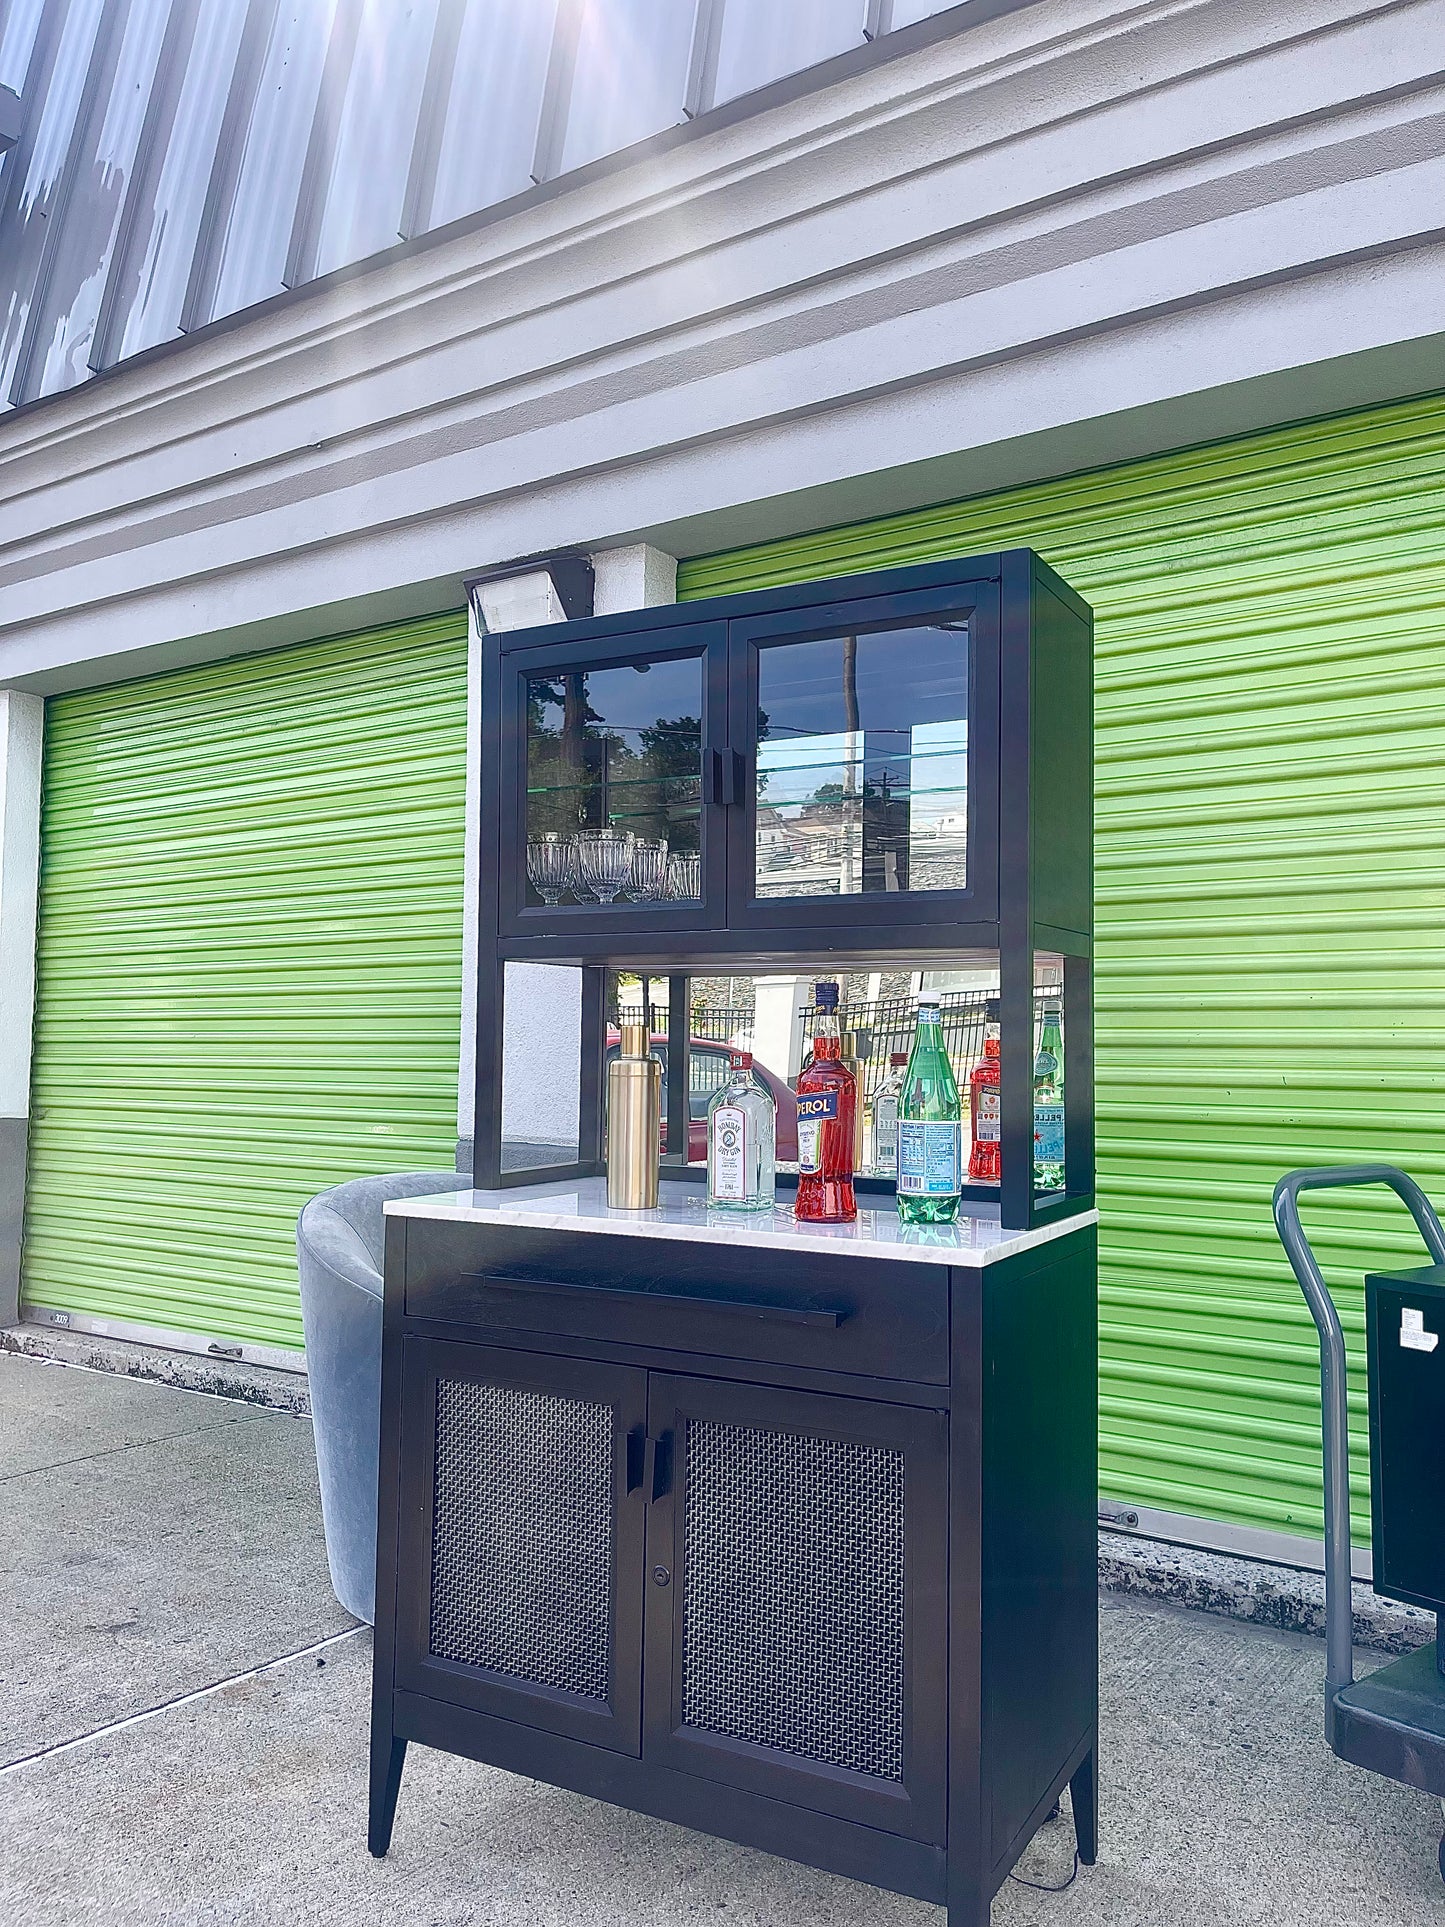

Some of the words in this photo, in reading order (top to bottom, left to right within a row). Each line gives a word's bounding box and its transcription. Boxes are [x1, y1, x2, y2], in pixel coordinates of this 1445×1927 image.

[797, 1099, 830, 1115] PEROL
[717, 1122, 741, 1133] BOMBAY
[717, 1145, 729, 1156] DRY
[730, 1145, 741, 1156] GIN
[54, 1313, 68, 1324] 3009
